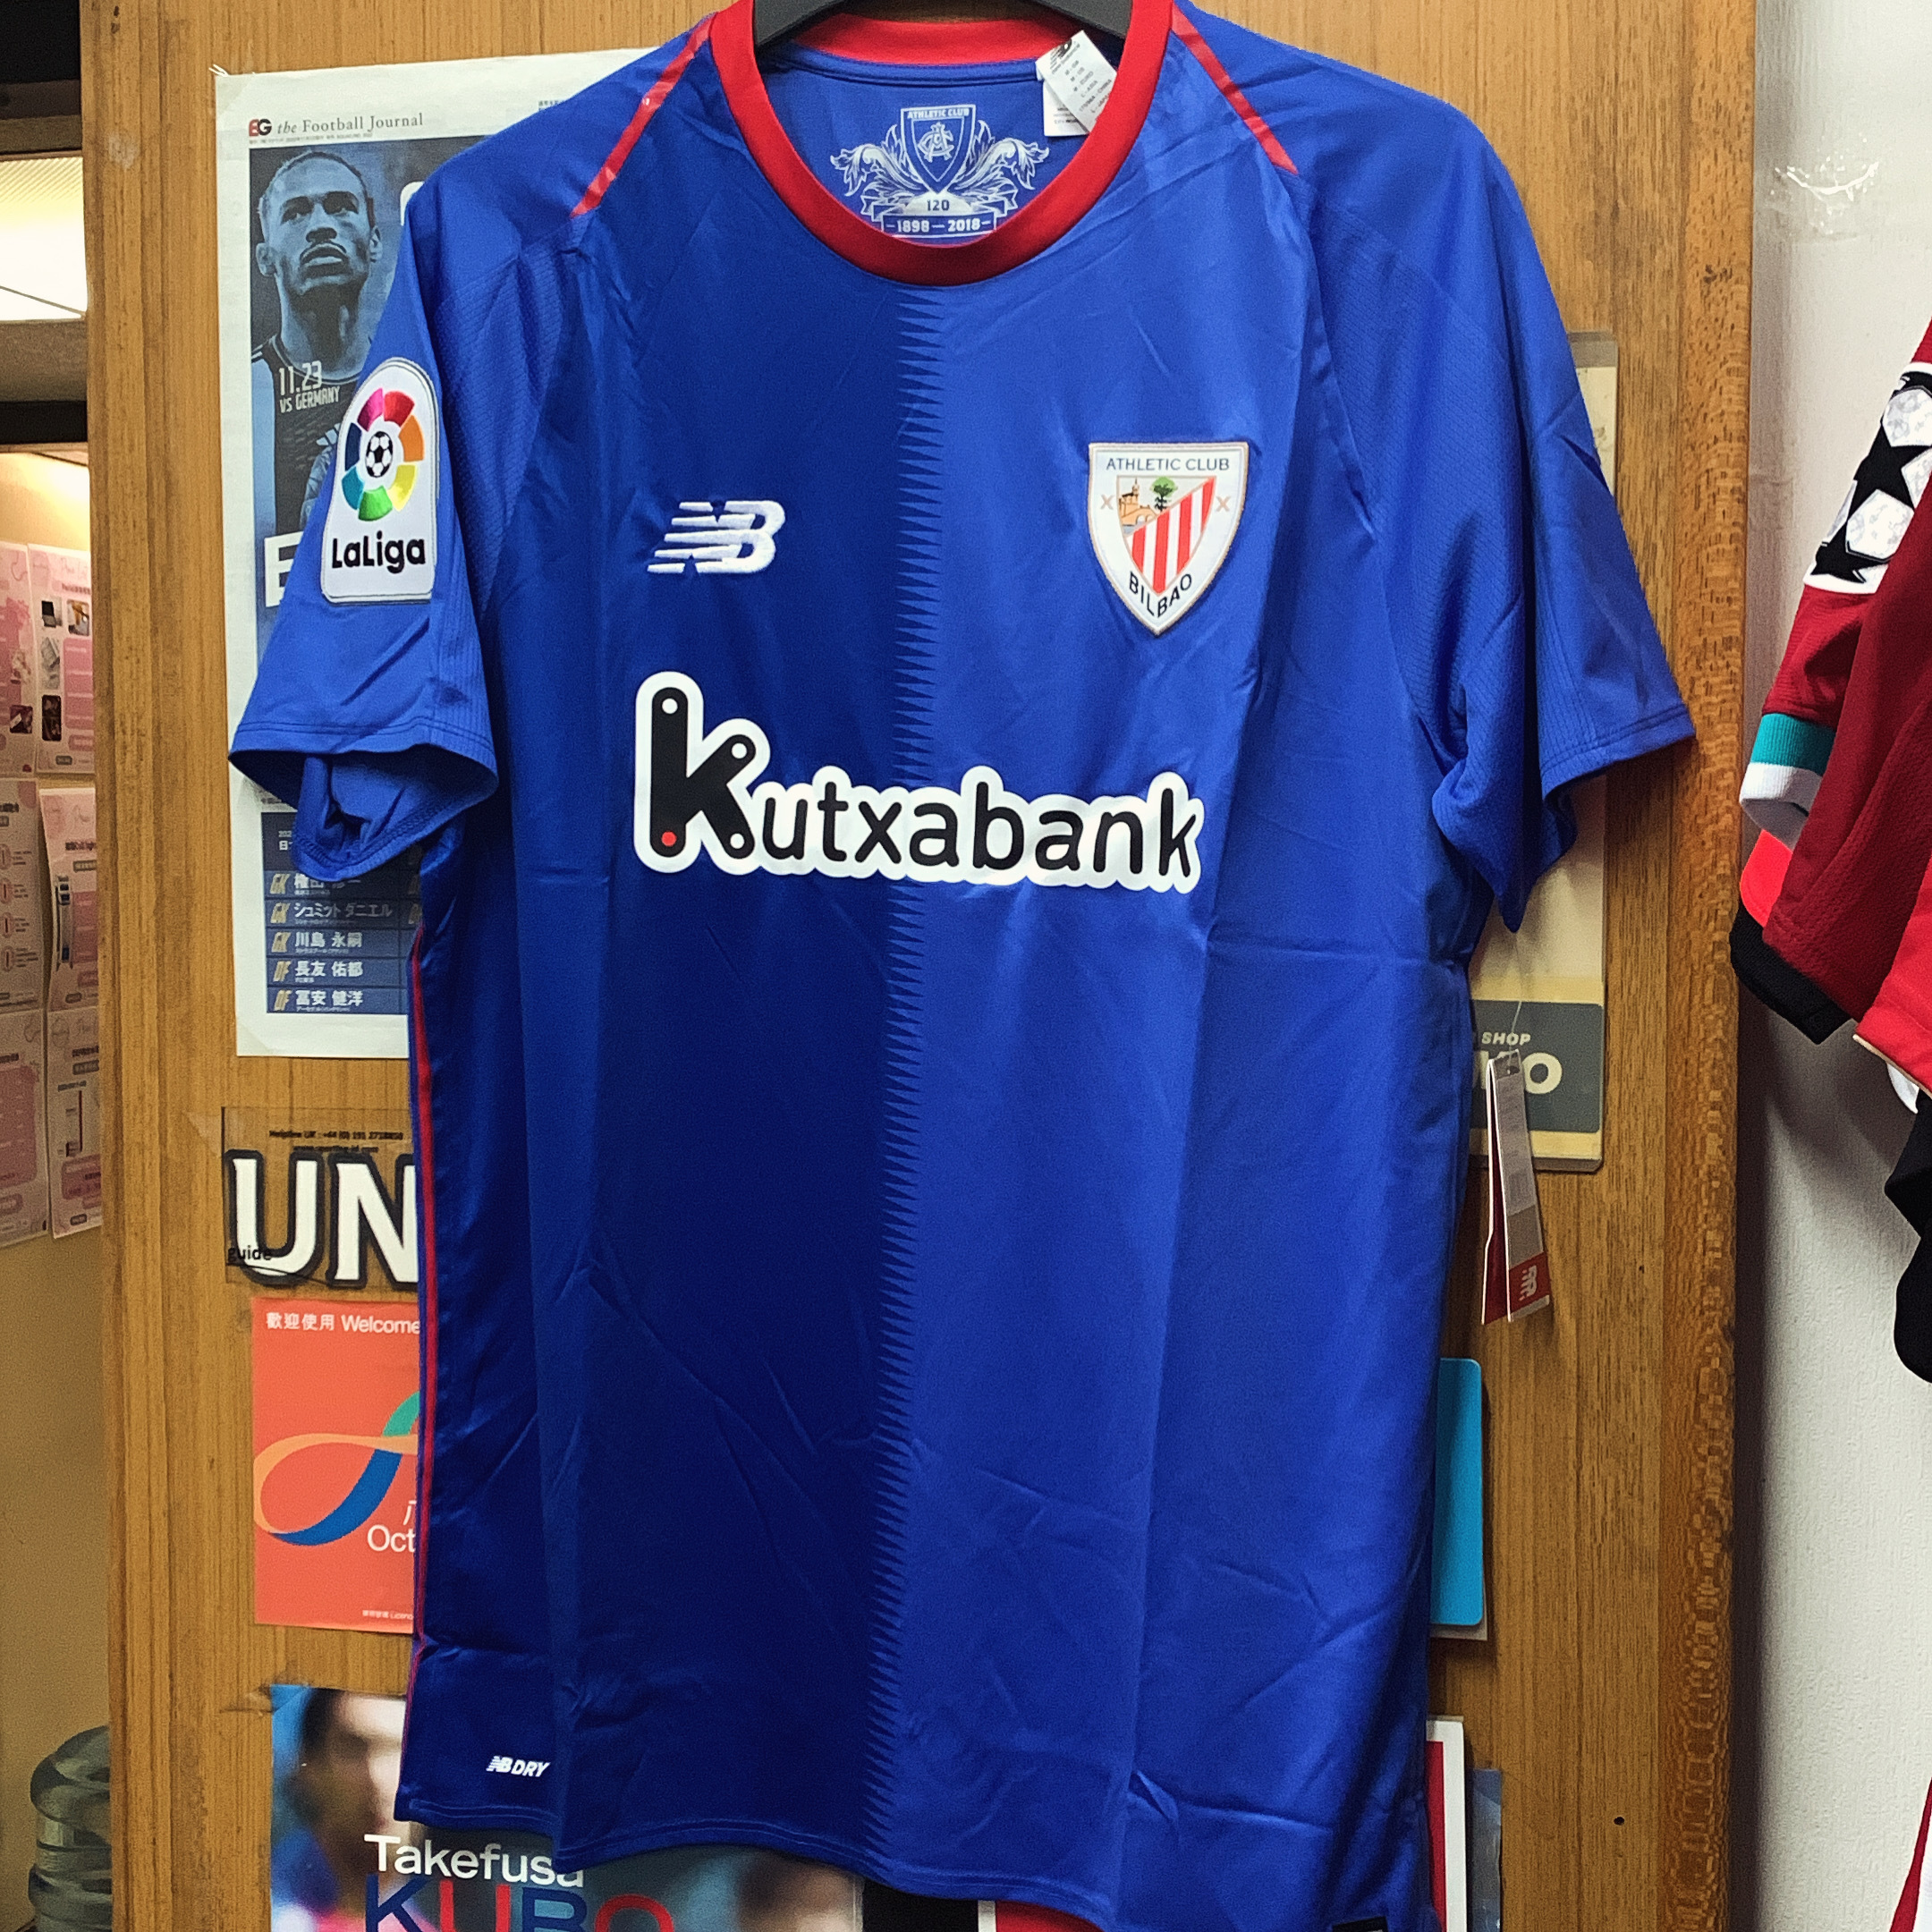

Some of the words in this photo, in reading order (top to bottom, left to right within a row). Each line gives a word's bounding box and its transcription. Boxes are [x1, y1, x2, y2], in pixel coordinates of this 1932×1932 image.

[277, 122, 297, 134] the
[302, 116, 363, 132] Football
[368, 113, 423, 132] Journal
[907, 109, 946, 119] ATHLETIC
[948, 107, 970, 117] CLUB
[927, 199, 950, 211] 120
[897, 219, 929, 233] 1898
[948, 217, 980, 232] 2018
[279, 360, 322, 395] 11.23
[279, 399, 292, 413] VS
[295, 386, 340, 411] GERMANY
[1106, 457, 1181, 470] ATHLETIC
[1185, 457, 1230, 470] CLUB
[332, 530, 426, 573] LaLiga
[1129, 571, 1192, 618] BILBAO
[641, 677, 1201, 886] Kutxabank
[1481, 1031, 1531, 1046] SHOP
[341, 1315, 420, 1335] Welcome
[367, 1524, 416, 1553] Oct
